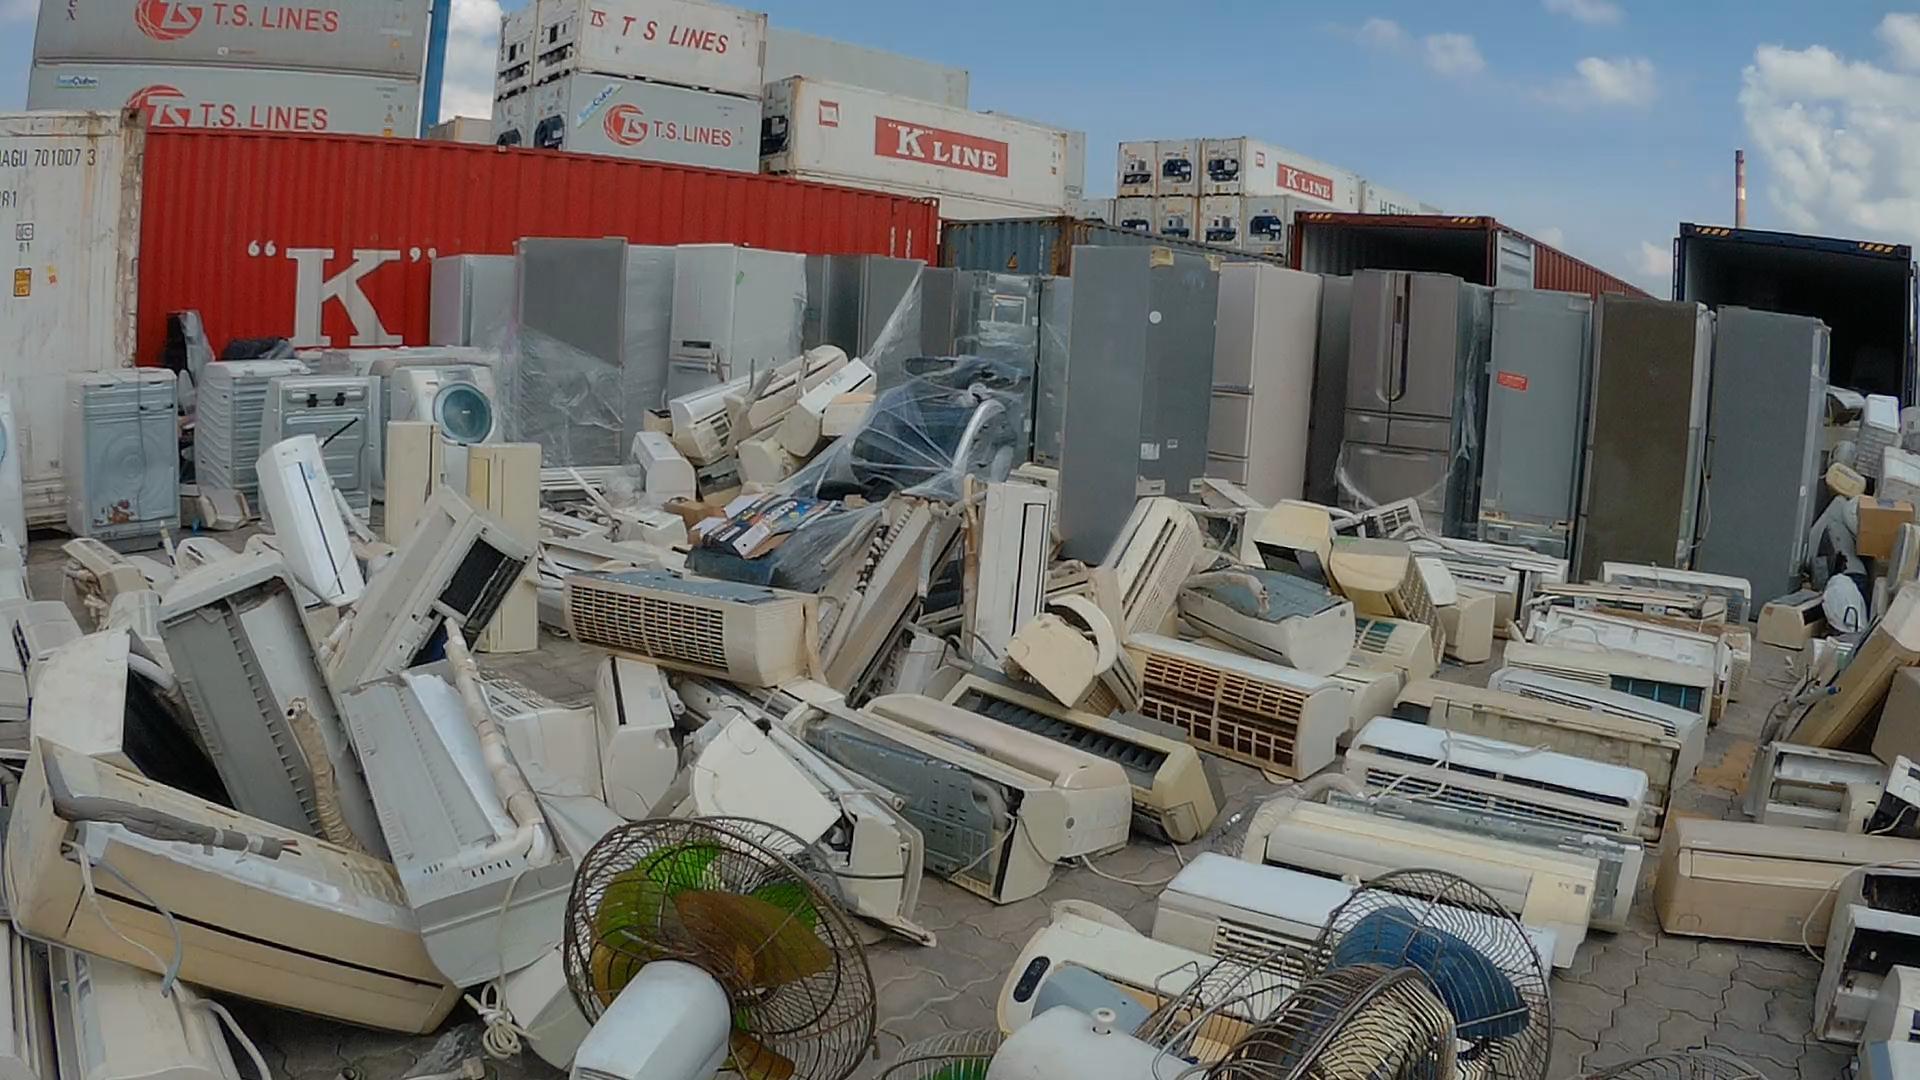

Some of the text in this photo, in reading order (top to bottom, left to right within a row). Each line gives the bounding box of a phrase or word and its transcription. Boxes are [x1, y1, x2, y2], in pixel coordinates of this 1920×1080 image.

[261, 6, 340, 33] LINES
[668, 25, 729, 54] LINES
[250, 106, 328, 130] LINES
[684, 125, 732, 147] LINES
[0, 149, 96, 168] AGU 701007 3
[934, 141, 997, 171] LINE
[0, 190, 17, 208] R1
[1301, 178, 1330, 198] LINE
